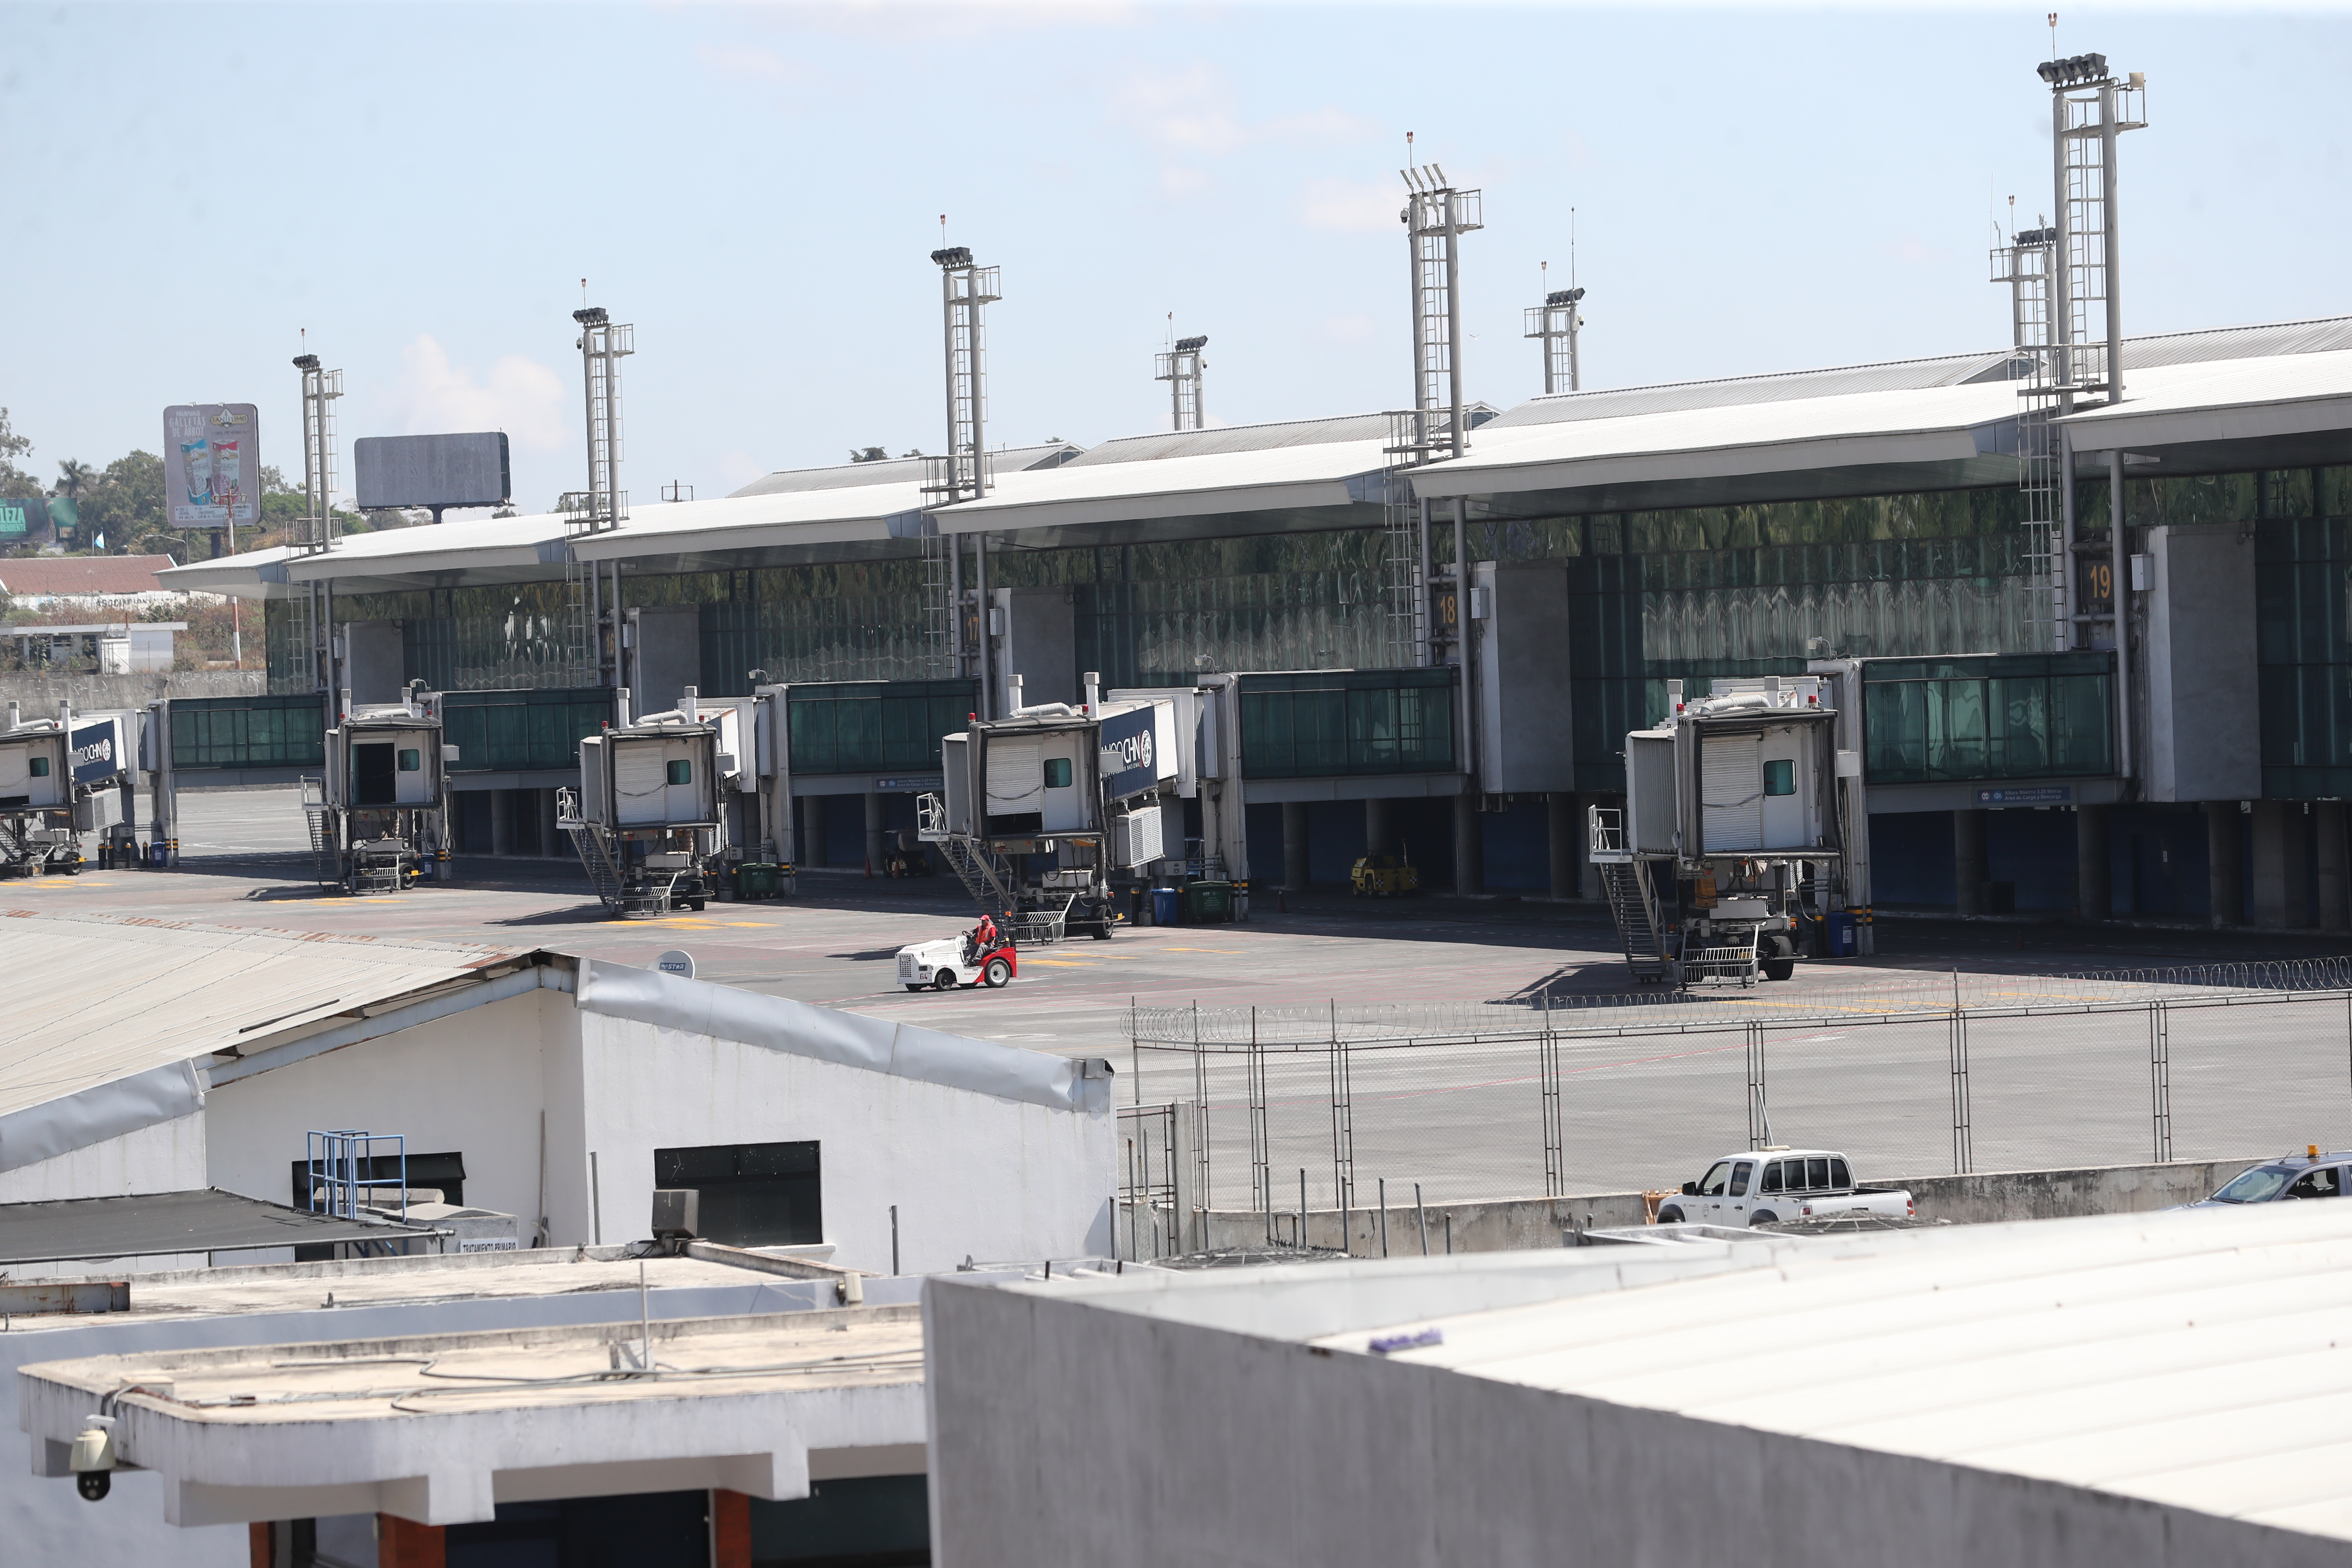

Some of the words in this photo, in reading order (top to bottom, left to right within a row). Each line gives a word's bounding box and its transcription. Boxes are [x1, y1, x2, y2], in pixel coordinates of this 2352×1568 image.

[169, 417, 206, 428] GALLETAS
[173, 428, 181, 437] DE
[184, 427, 204, 437] ARROZ
[2090, 565, 2110, 598] 19
[1440, 596, 1455, 624] 18
[968, 616, 979, 640] 17
[606, 633, 614, 654] 16
[1127, 762, 1140, 771] NACIONAL
[463, 1243, 494, 1253] TRATAMIENTO
[495, 1242, 516, 1251] PRIMARIO
